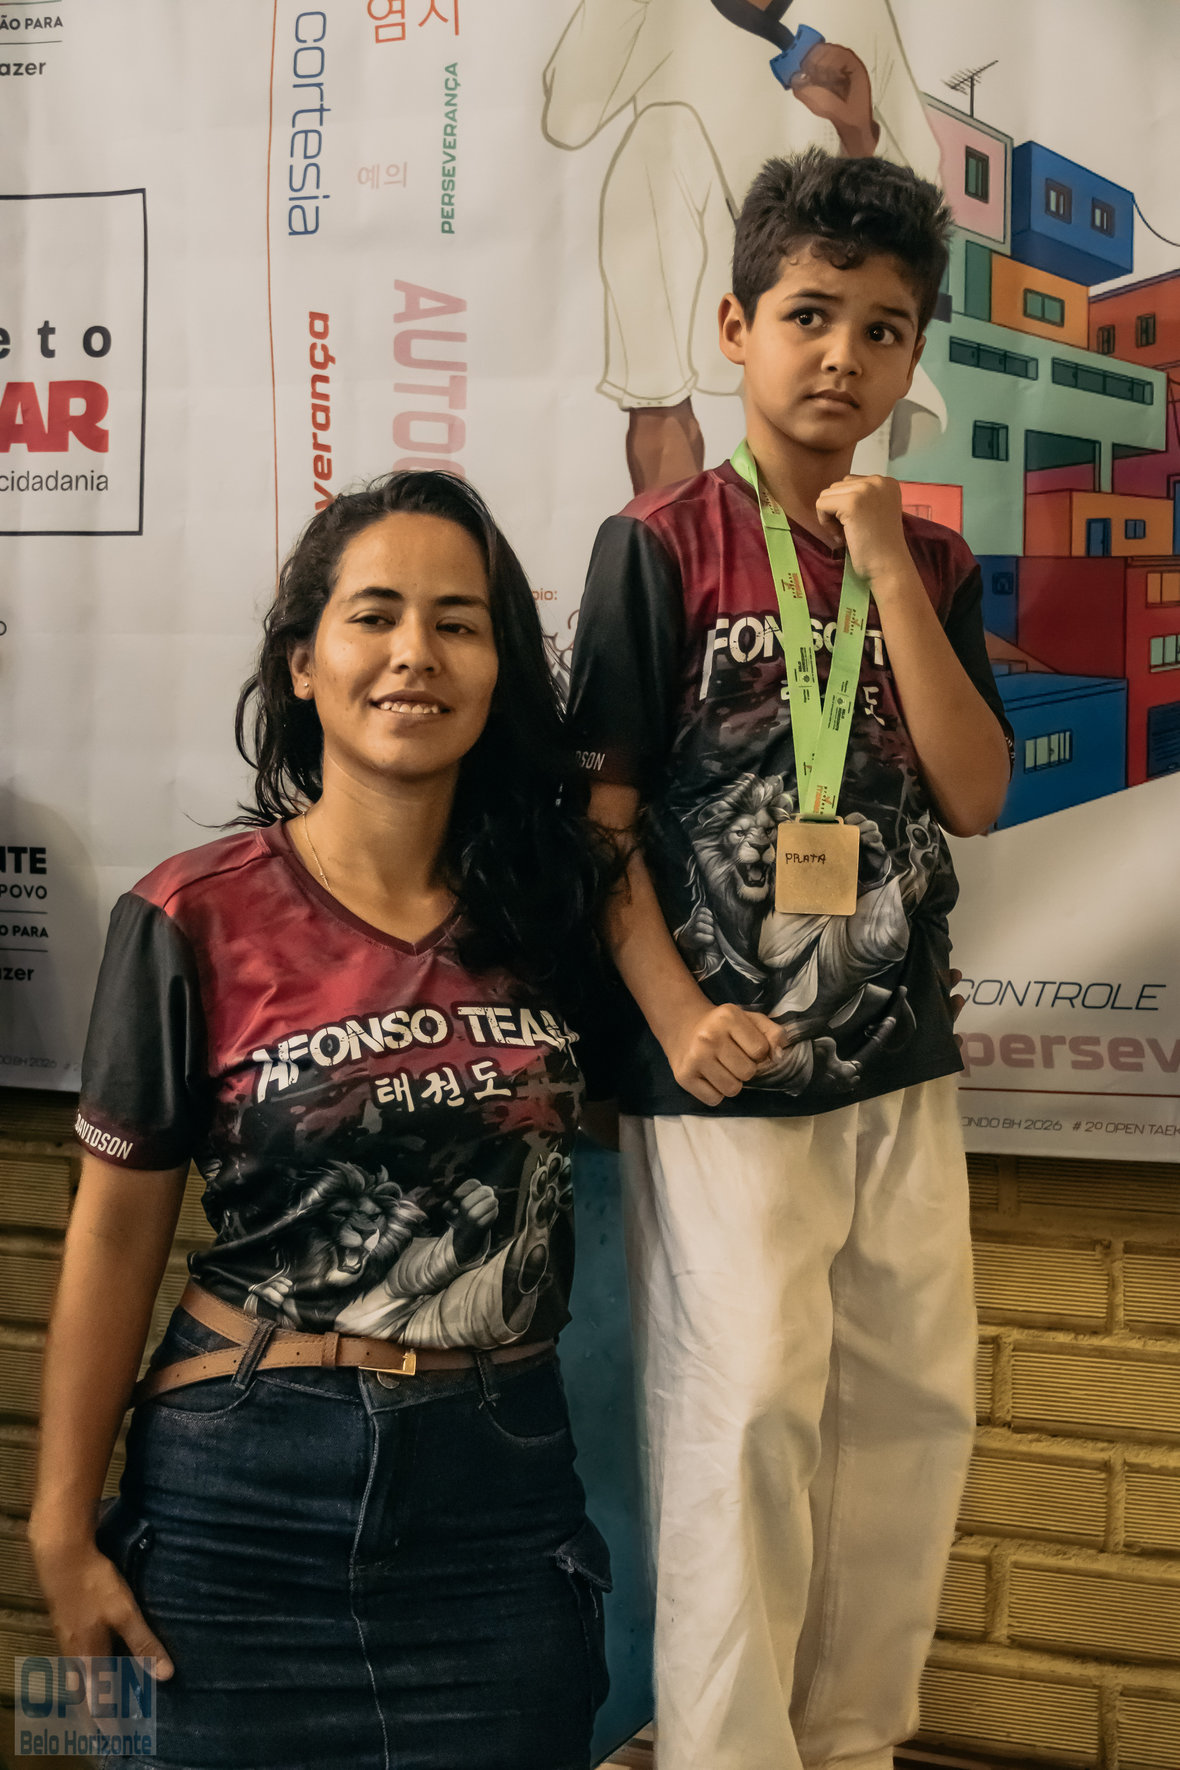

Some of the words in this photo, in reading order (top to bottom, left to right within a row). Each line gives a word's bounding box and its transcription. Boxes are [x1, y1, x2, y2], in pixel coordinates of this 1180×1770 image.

[24, 16, 64, 30] PARA
[288, 11, 331, 236] cortesia
[441, 62, 461, 234] PERSEVERANÇA
[357, 161, 408, 190] 예의
[392, 279, 467, 479] AUTO
[0, 470, 109, 491] cidadania
[785, 853, 826, 864] PRATA
[12, 925, 49, 938] PARA
[374, 1060, 512, 1113] 태권도
[1002, 1118, 1022, 1129] BH
[1023, 1118, 1063, 1132] 2026
[1105, 1122, 1146, 1135] OPEN
